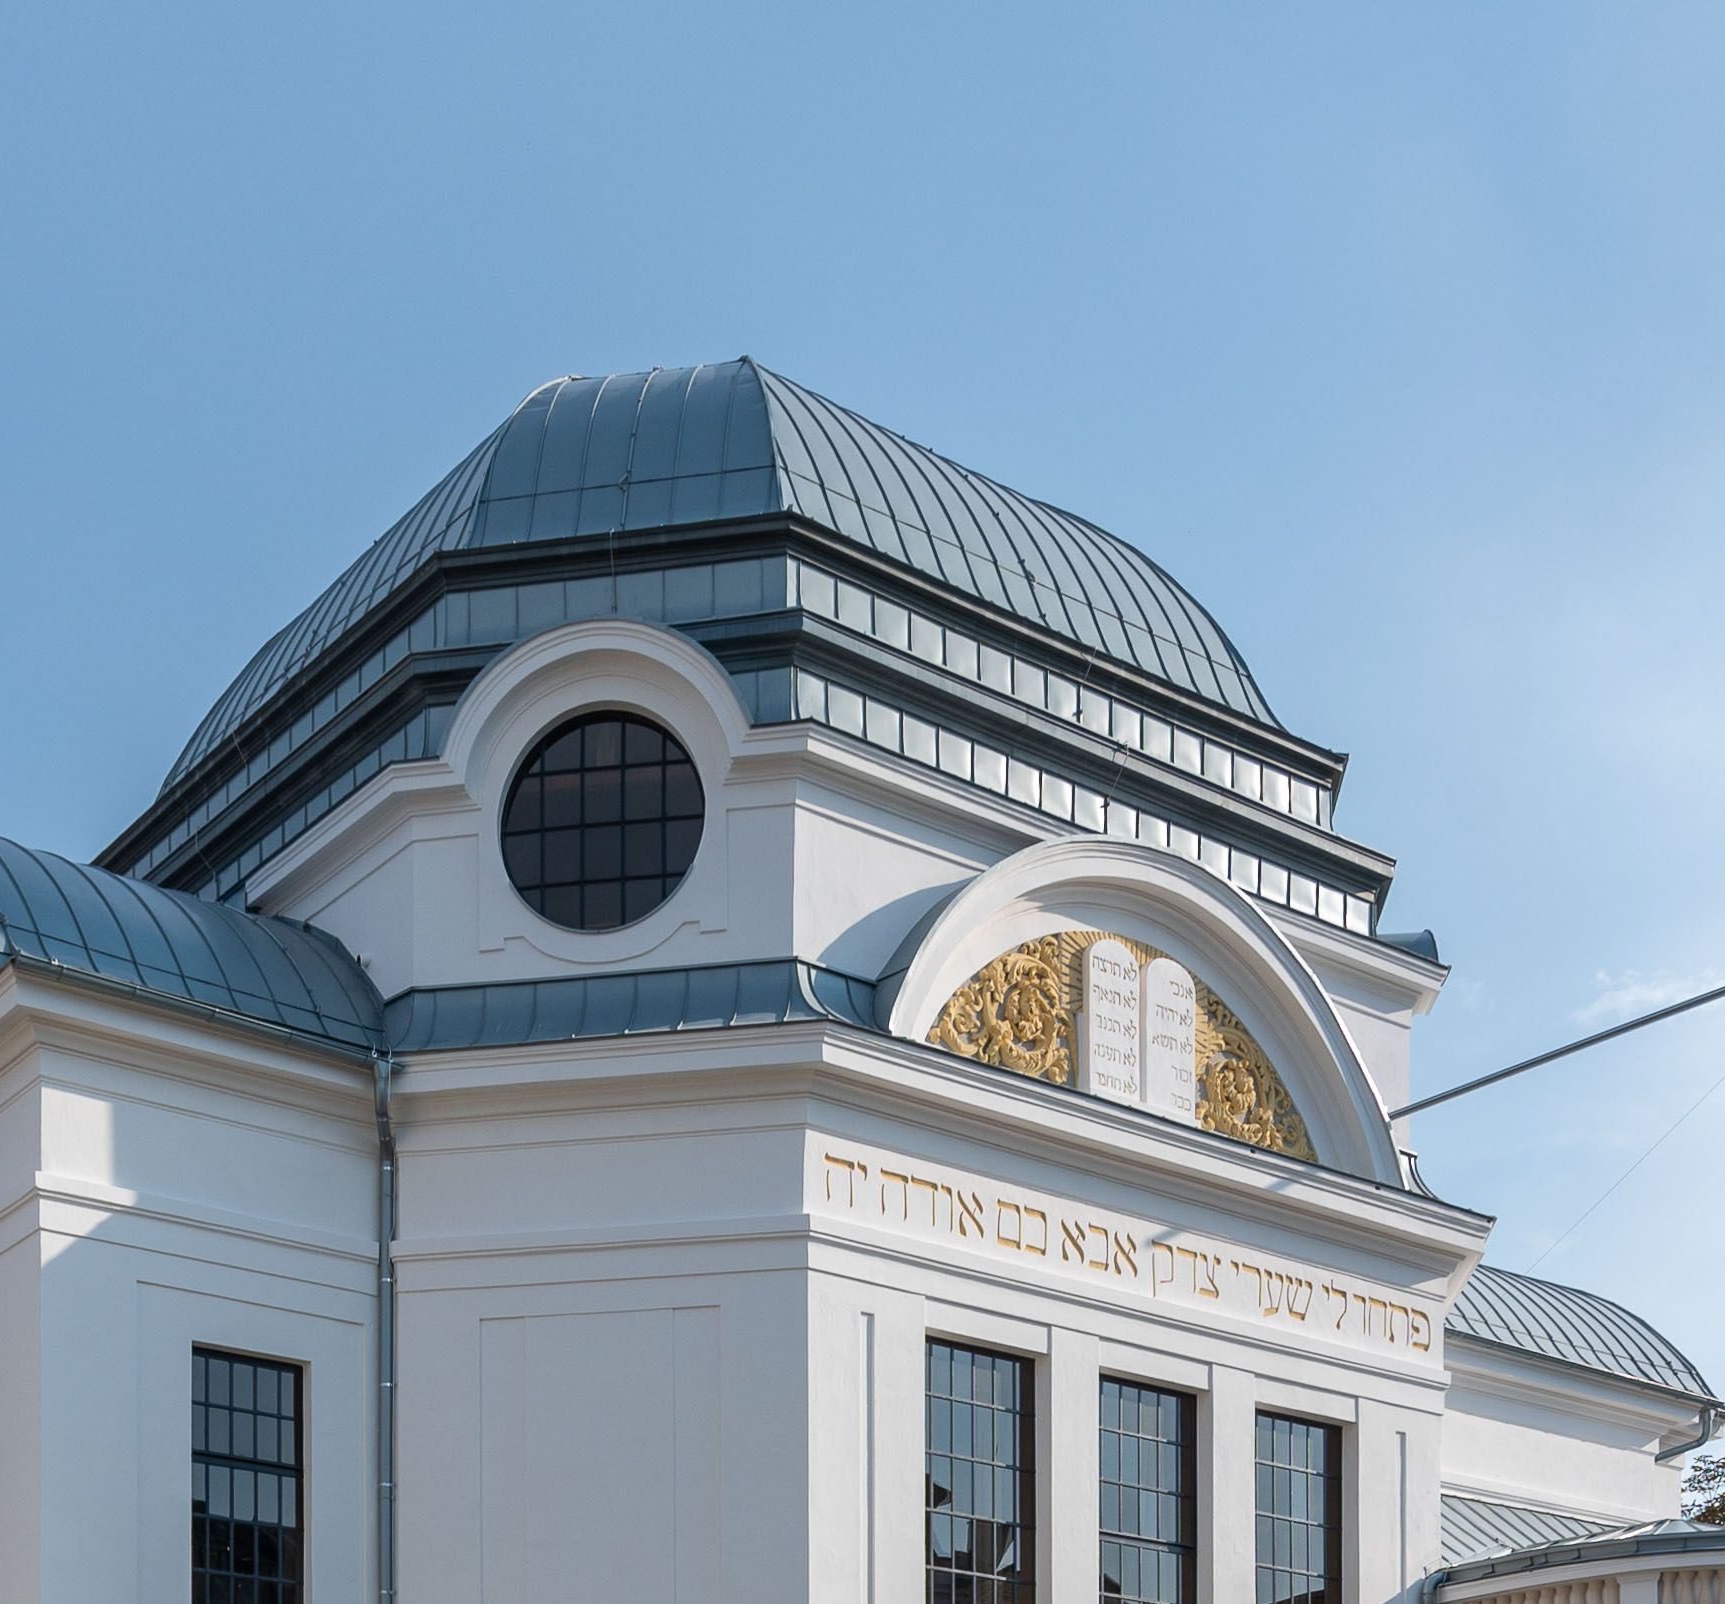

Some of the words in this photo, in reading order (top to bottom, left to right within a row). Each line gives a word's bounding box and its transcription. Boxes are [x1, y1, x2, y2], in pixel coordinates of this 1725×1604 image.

[1123, 962, 1137, 982] לא
[1123, 990, 1137, 1011] לא
[1123, 1018, 1137, 1039] לא
[1179, 1008, 1193, 1028] לא
[1152, 1032, 1178, 1051] תשא
[1180, 1036, 1194, 1056] לא
[1123, 1047, 1137, 1067] לא
[1123, 1075, 1138, 1095] לא
[823, 1151, 868, 1209] יה
[880, 1167, 985, 1239] אודה
[1060, 1218, 1138, 1279] אבא
[1151, 1239, 1221, 1299] צדק
[1230, 1260, 1314, 1322] שערי
[1321, 1279, 1348, 1331] לי
[1353, 1293, 1431, 1352] פתחו
